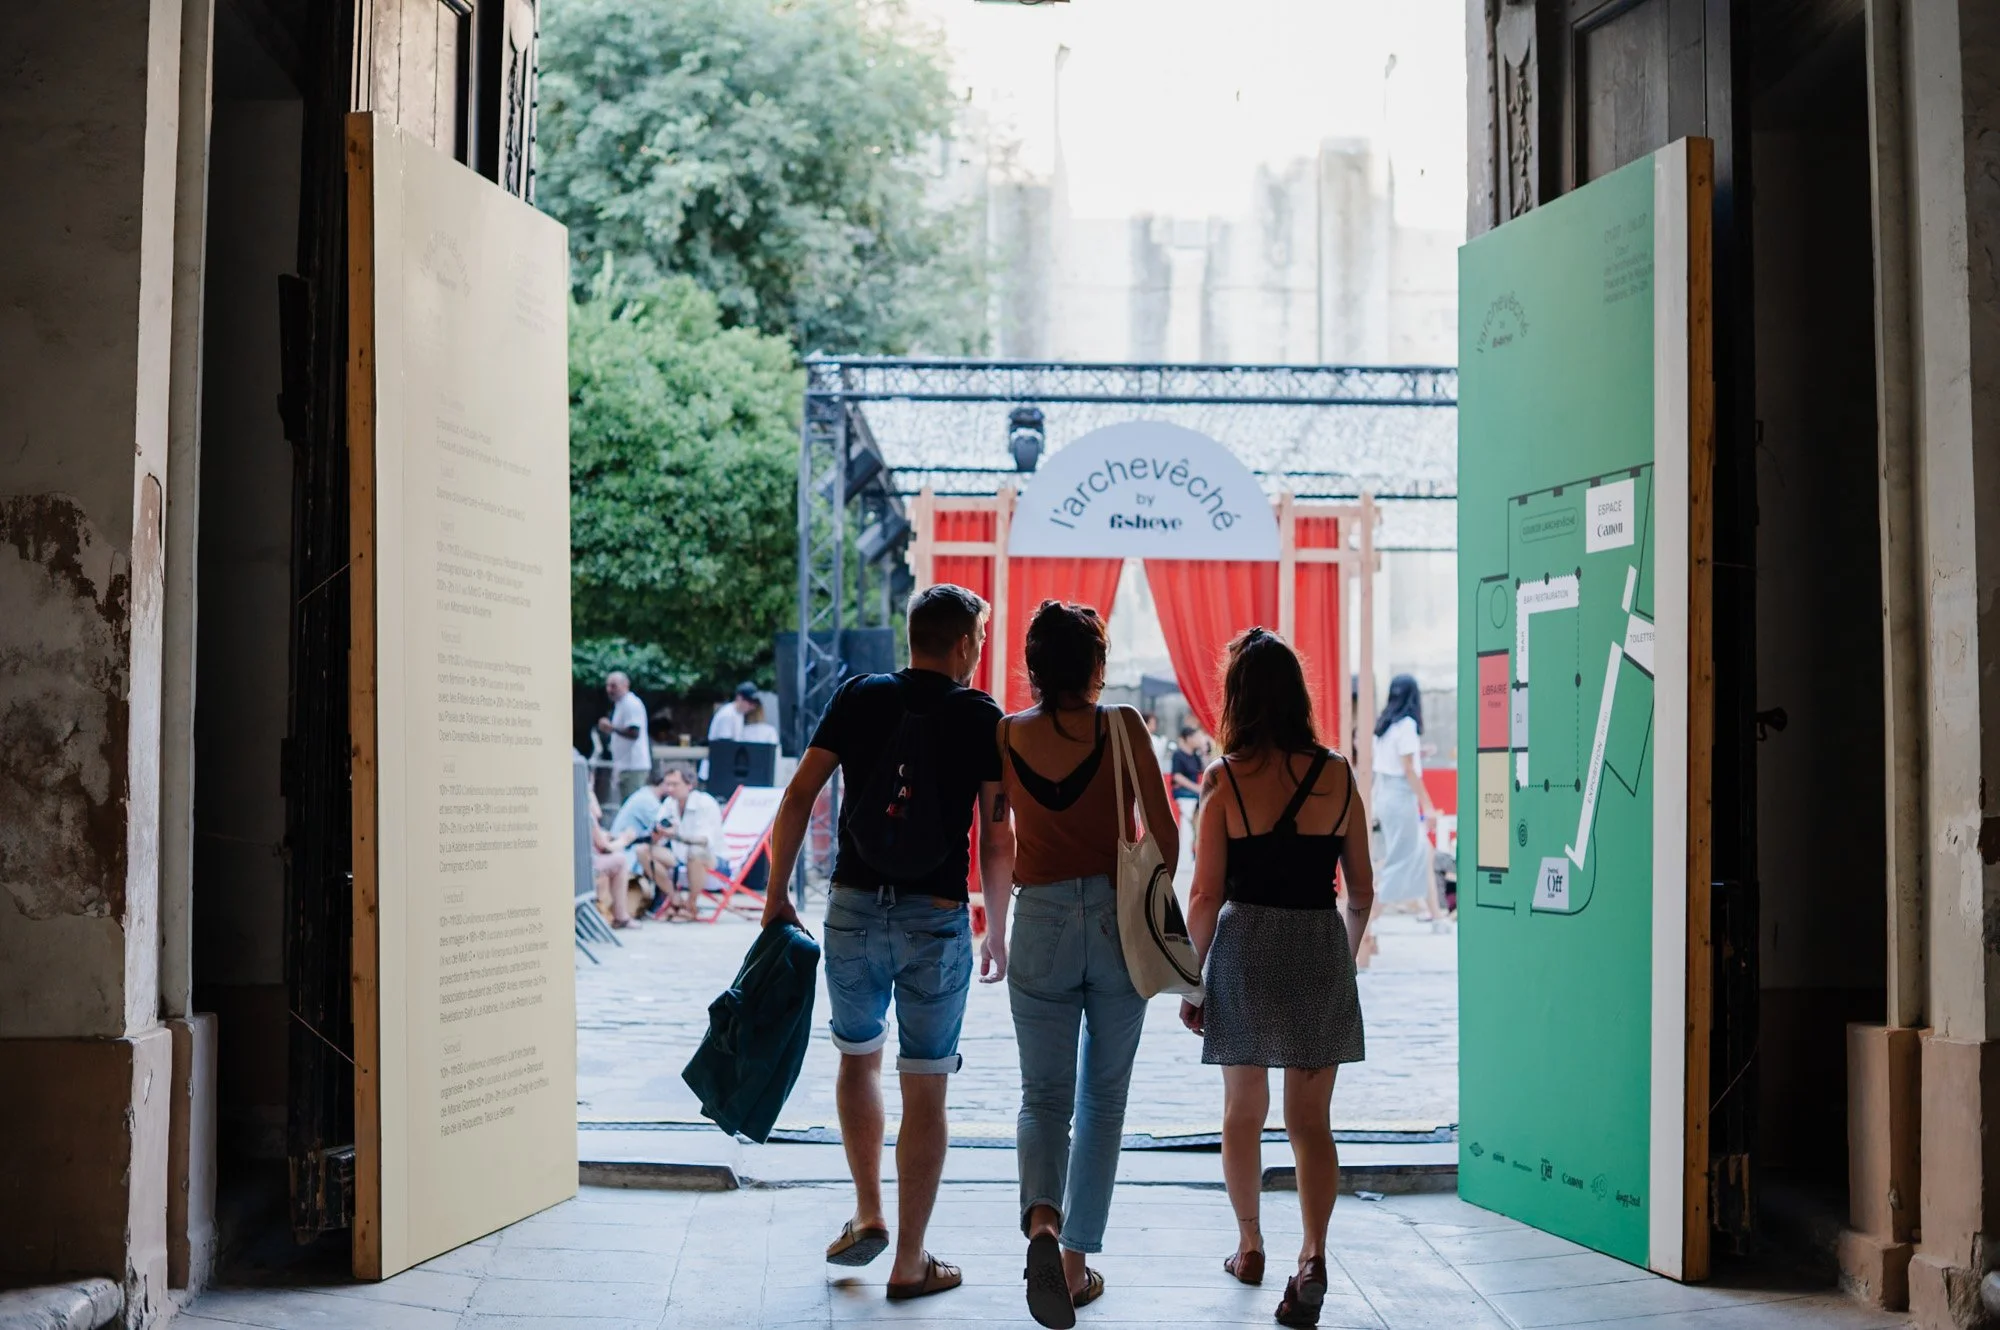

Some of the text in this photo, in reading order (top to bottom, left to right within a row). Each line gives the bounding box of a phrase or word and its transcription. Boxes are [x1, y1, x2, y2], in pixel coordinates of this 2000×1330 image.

[1050, 457, 1242, 531] l'archevêché
[1136, 492, 1155, 508] by
[1598, 500, 1622, 516] ESPACE
[1110, 513, 1182, 533] fisheye
[1597, 521, 1623, 538] Canon
